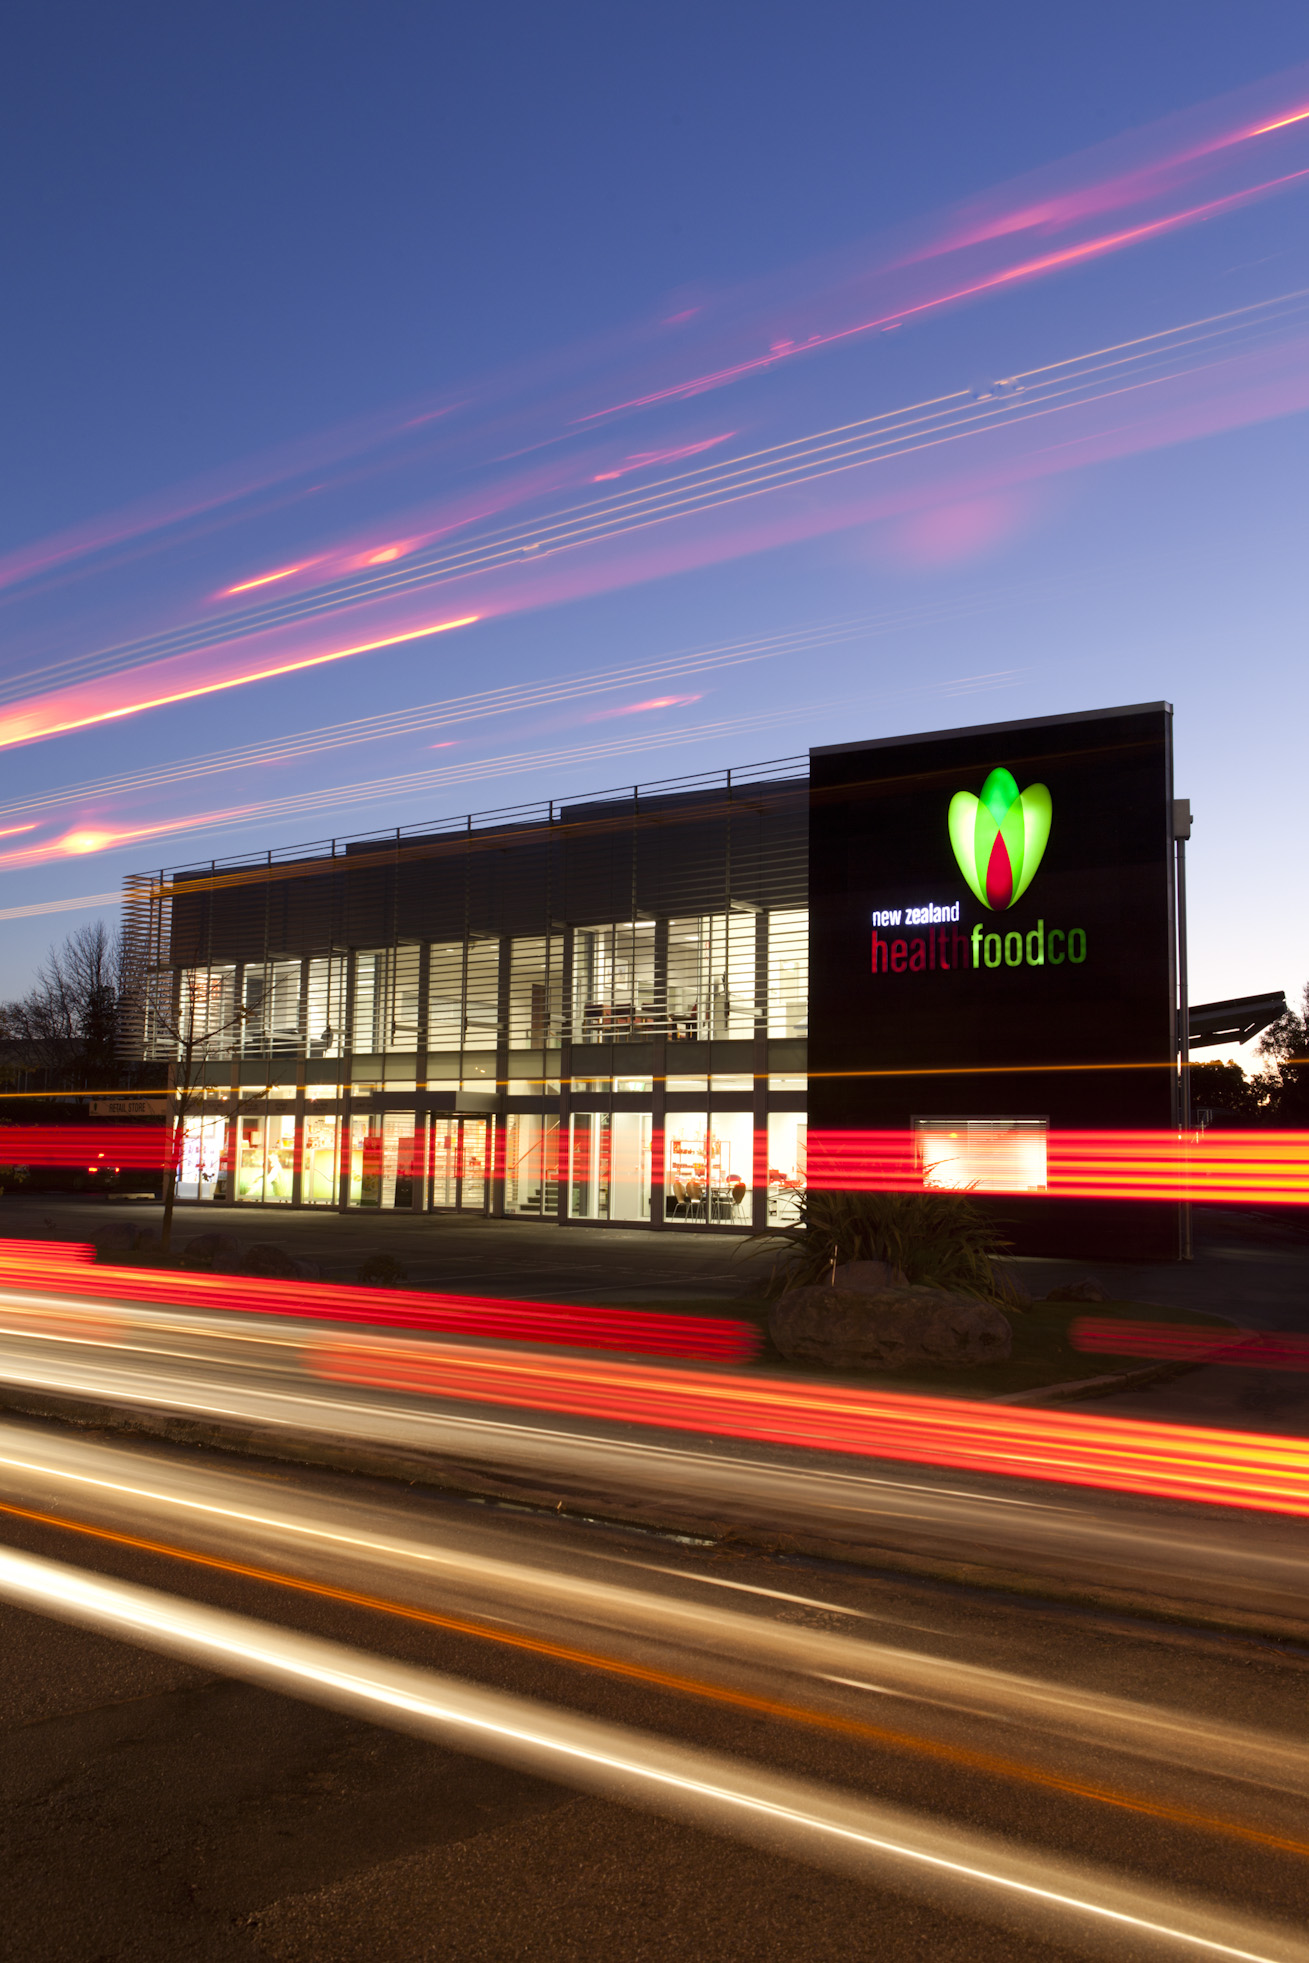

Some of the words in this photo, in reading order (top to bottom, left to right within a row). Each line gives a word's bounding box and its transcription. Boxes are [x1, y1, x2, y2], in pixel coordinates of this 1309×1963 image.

[872, 909, 901, 927] new
[905, 900, 960, 926] zealand
[109, 1103, 127, 1113] RETAIL
[128, 1102, 146, 1113] STORE
